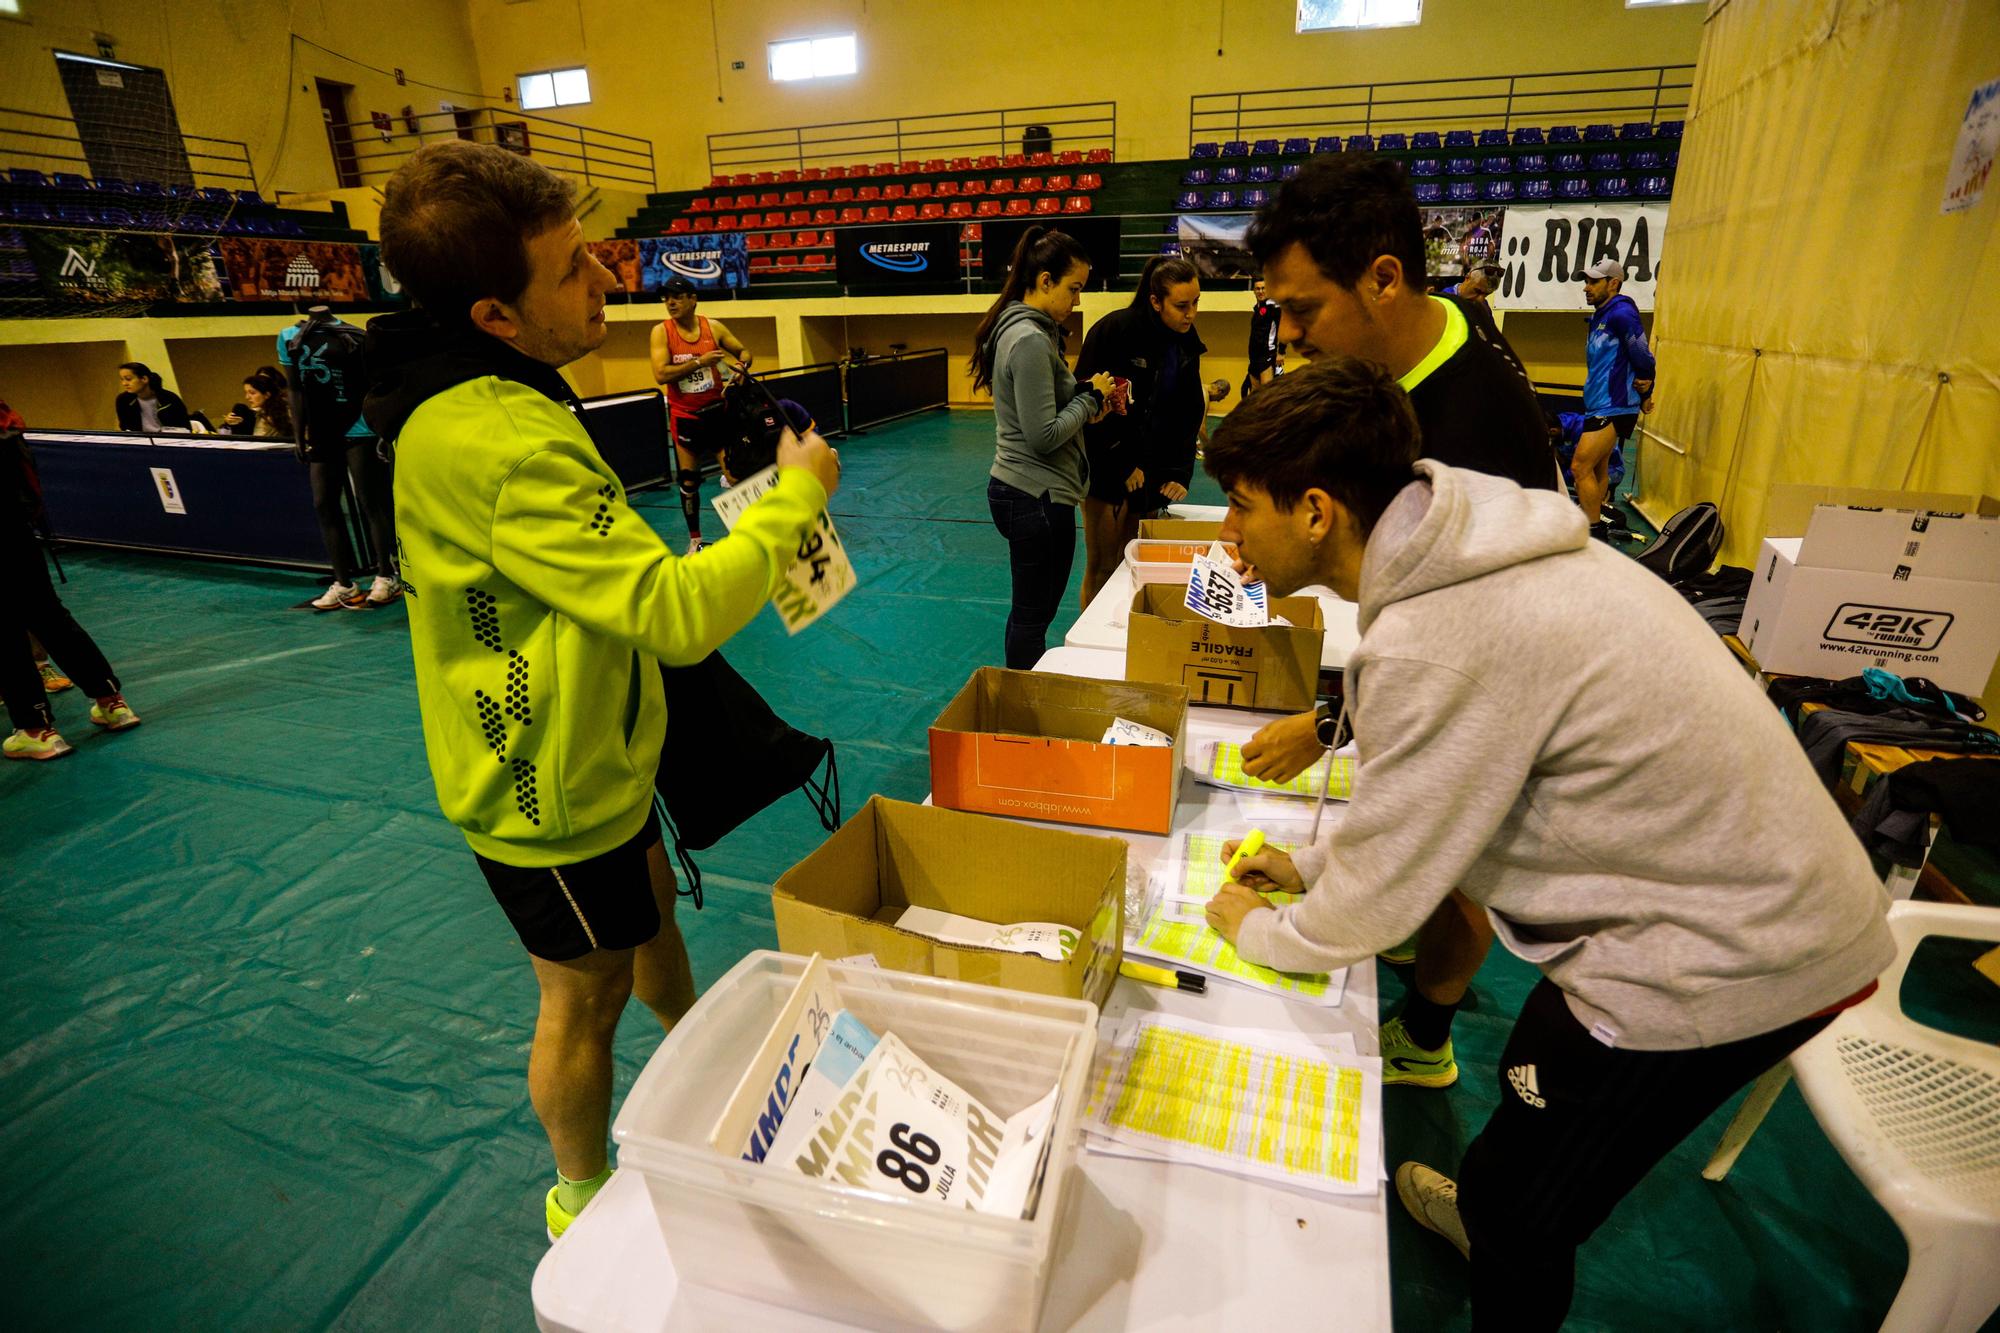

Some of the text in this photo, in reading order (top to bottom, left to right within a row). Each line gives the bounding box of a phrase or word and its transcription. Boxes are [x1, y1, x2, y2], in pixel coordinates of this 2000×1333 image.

[670, 250, 721, 262] METAESPORT
[869, 241, 930, 254] METAESPORT
[1538, 215, 1653, 282] RIBA
[1205, 570, 1235, 614] 5637
[1843, 612, 1935, 637] 42K
[1191, 641, 1254, 657] FRAGILE
[1874, 632, 1923, 646] running
[1819, 642, 1940, 663] www.42krunning.com
[998, 798, 1092, 816] www.labbox.com
[1506, 1066, 1548, 1109] adidas
[876, 1122, 941, 1194] 86
[935, 1164, 957, 1201] JULIA
